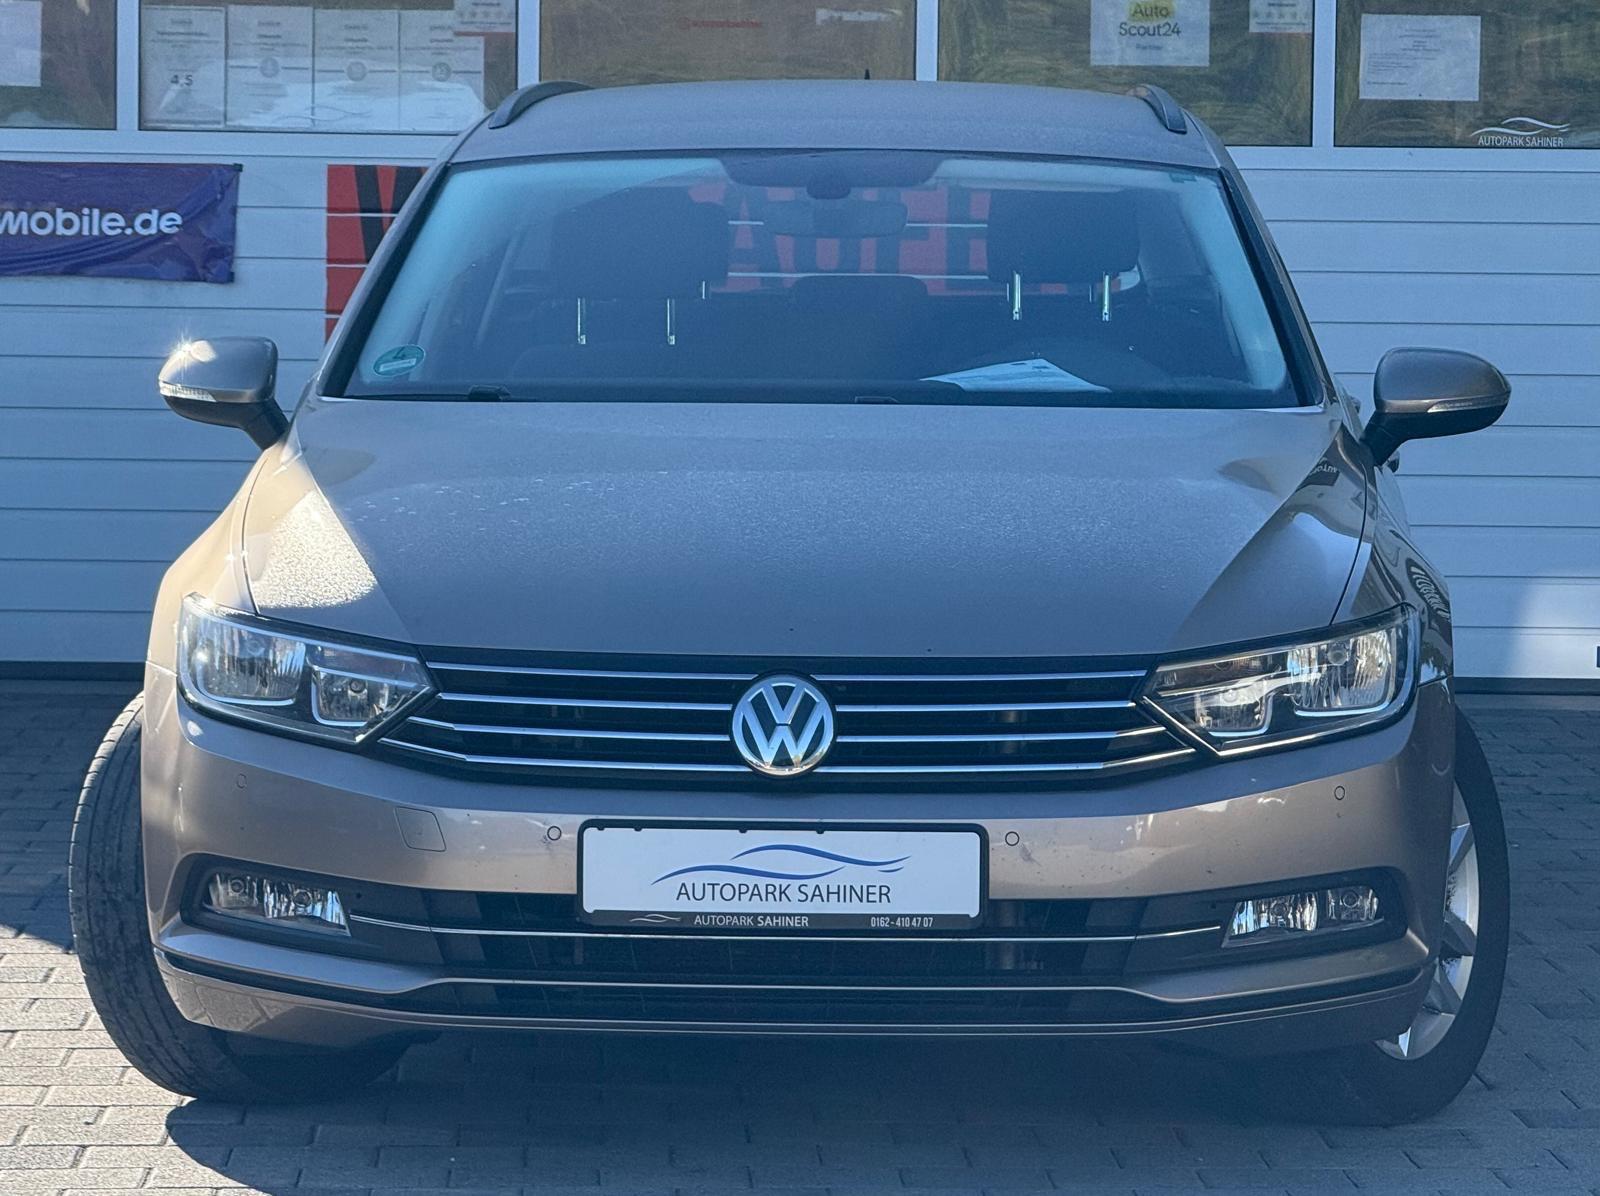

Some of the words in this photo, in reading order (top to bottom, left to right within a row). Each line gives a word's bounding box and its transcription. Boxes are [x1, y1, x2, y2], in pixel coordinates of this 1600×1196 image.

[1132, 3, 1169, 18] Auto
[1119, 22, 1181, 37] Scout24
[1478, 136, 1525, 147] AUTOPARK
[1525, 136, 1564, 147] SAHINER
[0, 207, 183, 236] mobile.de
[676, 882, 792, 902] AUTOPARK
[797, 884, 892, 904] SAHINER
[694, 914, 754, 926] AUTOPARK
[757, 916, 809, 927] SAHINER
